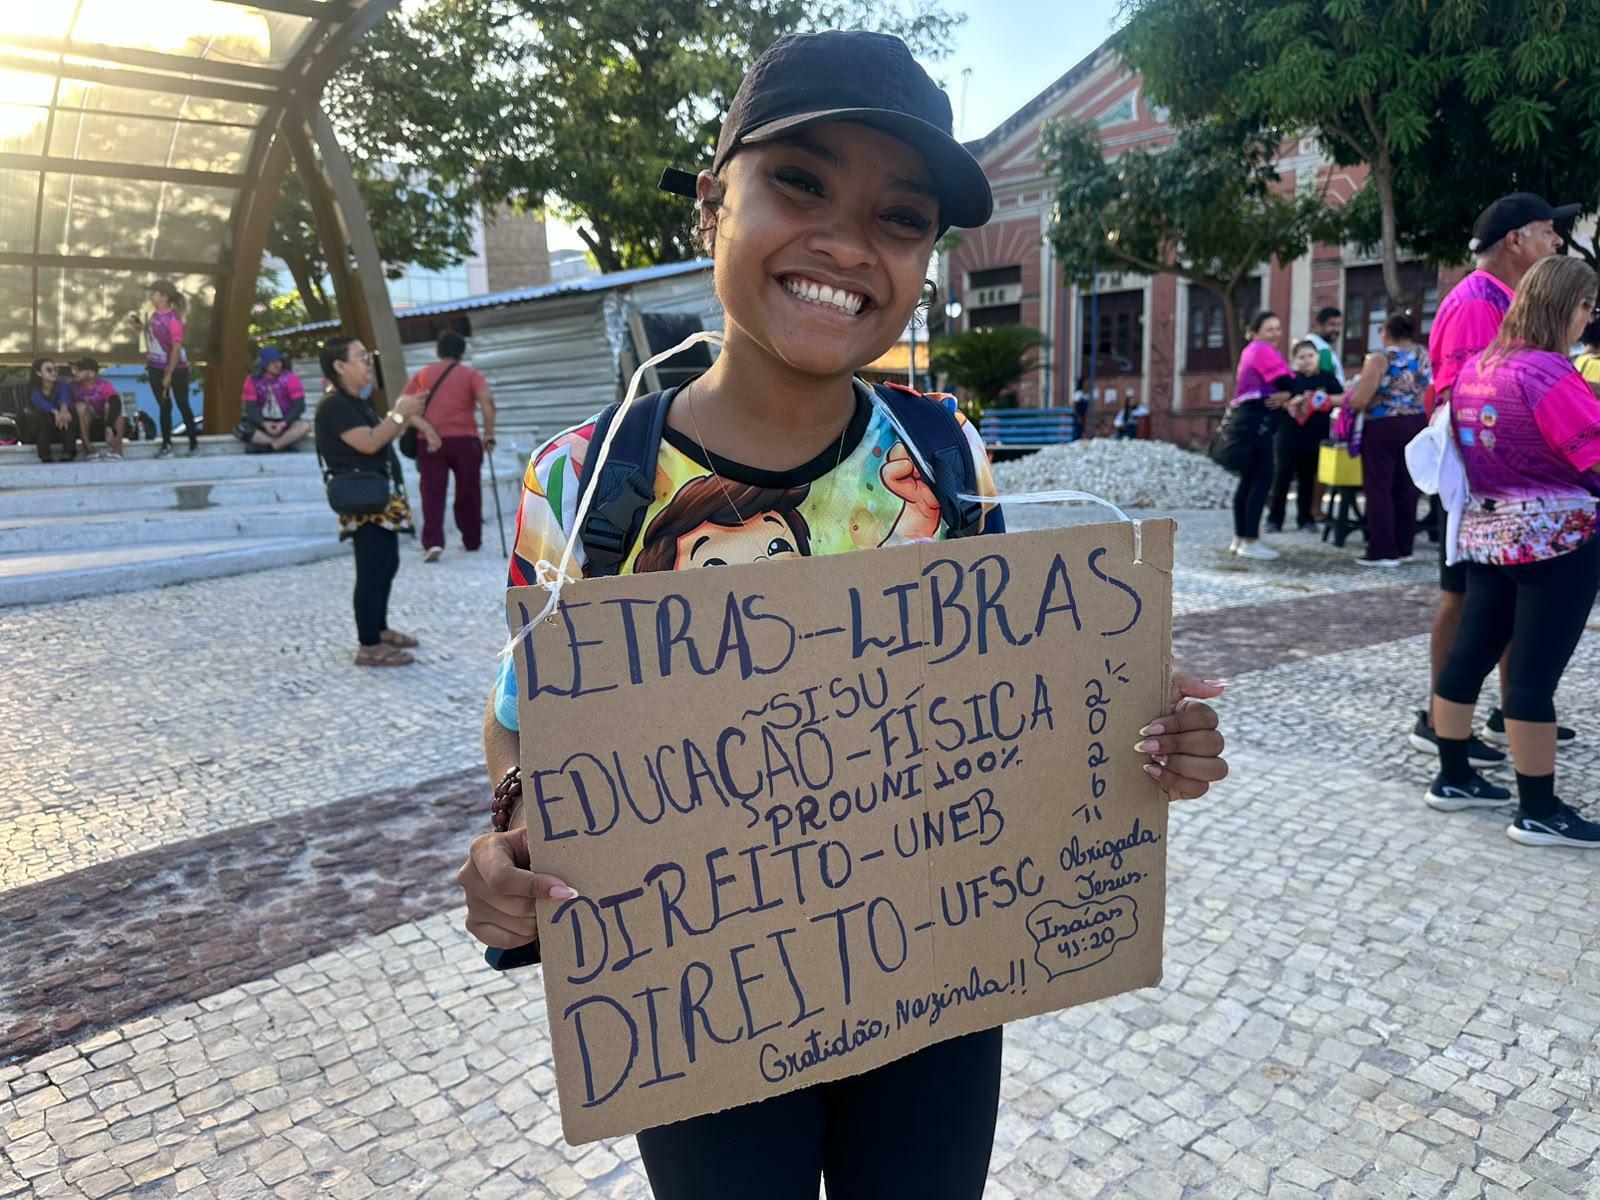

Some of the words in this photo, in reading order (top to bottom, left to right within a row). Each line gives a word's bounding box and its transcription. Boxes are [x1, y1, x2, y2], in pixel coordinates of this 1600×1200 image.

[759, 667, 889, 730] SISU
[764, 763, 923, 846] PROUNI
[933, 745, 1023, 790] 100%
[1057, 926, 1115, 959] 41:20
